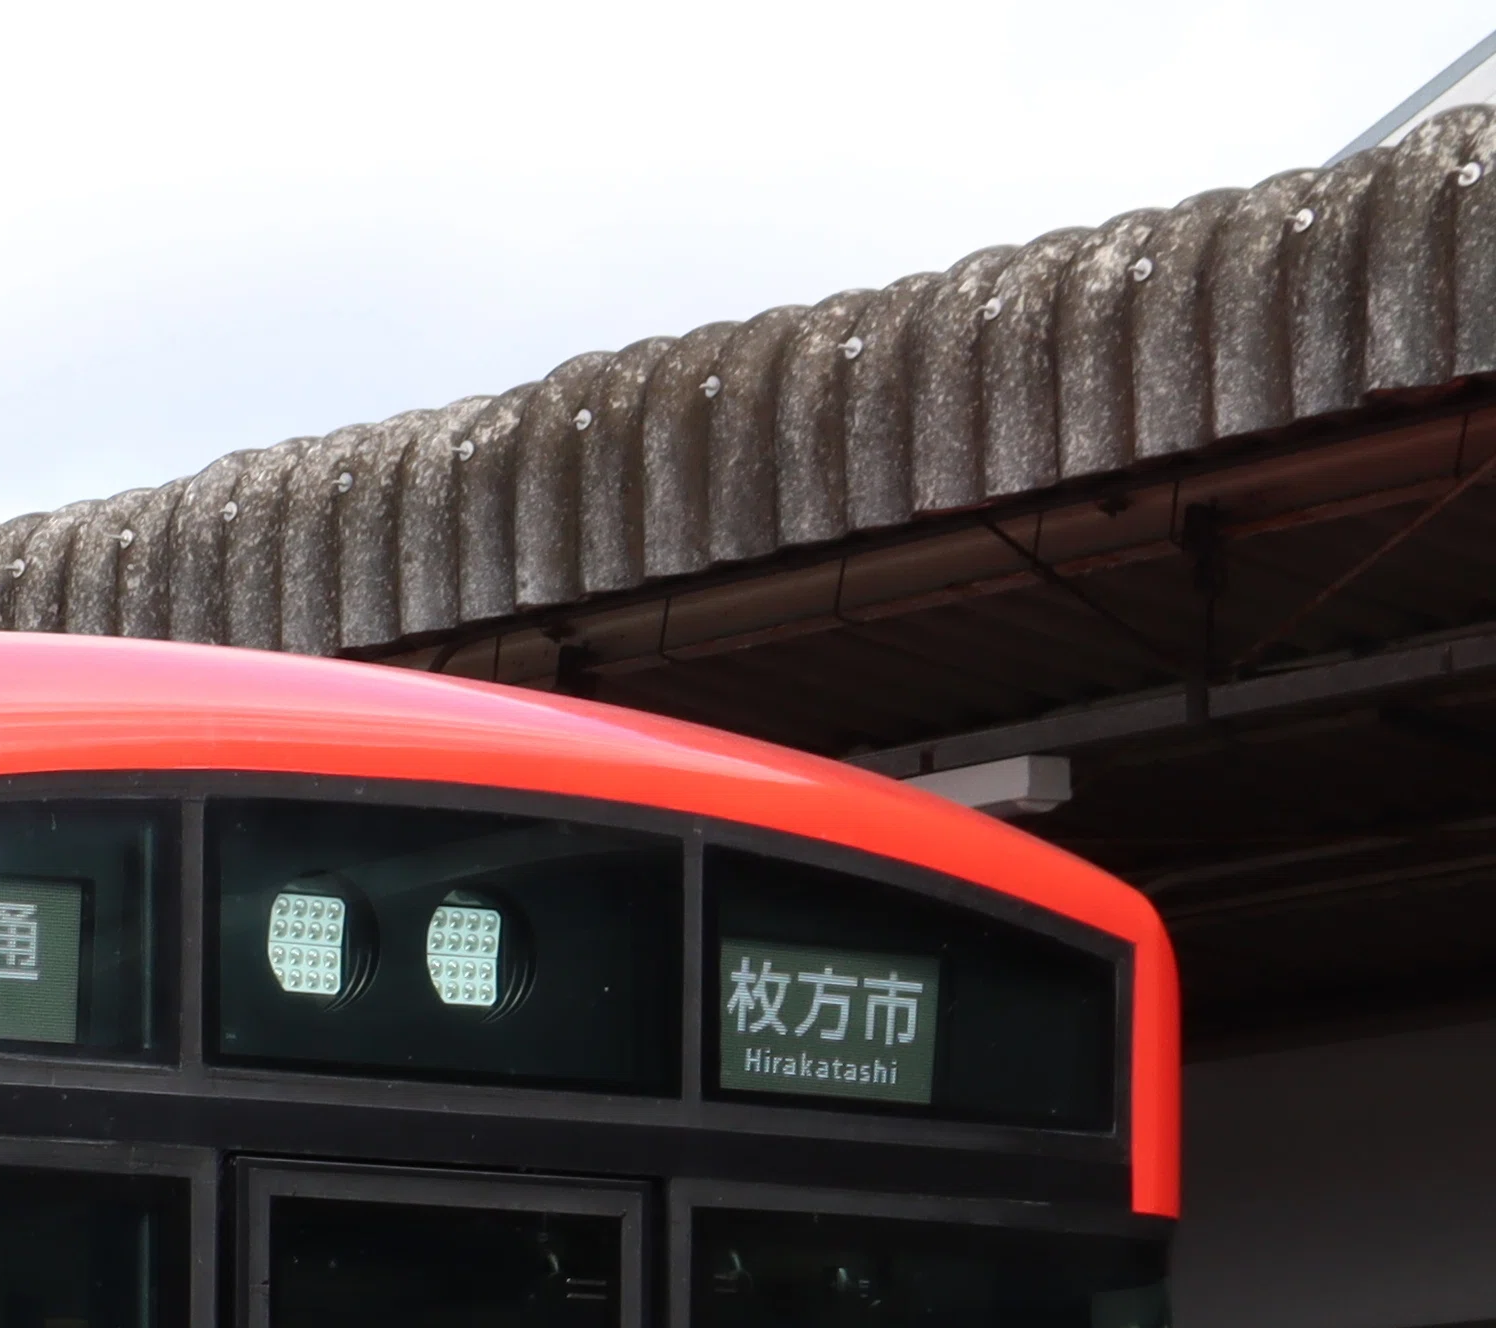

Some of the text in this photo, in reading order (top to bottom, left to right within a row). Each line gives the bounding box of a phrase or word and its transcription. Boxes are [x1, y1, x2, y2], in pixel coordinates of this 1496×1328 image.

[727, 956, 924, 1046] 枚方市
[743, 1047, 899, 1085] Hirakatashi
